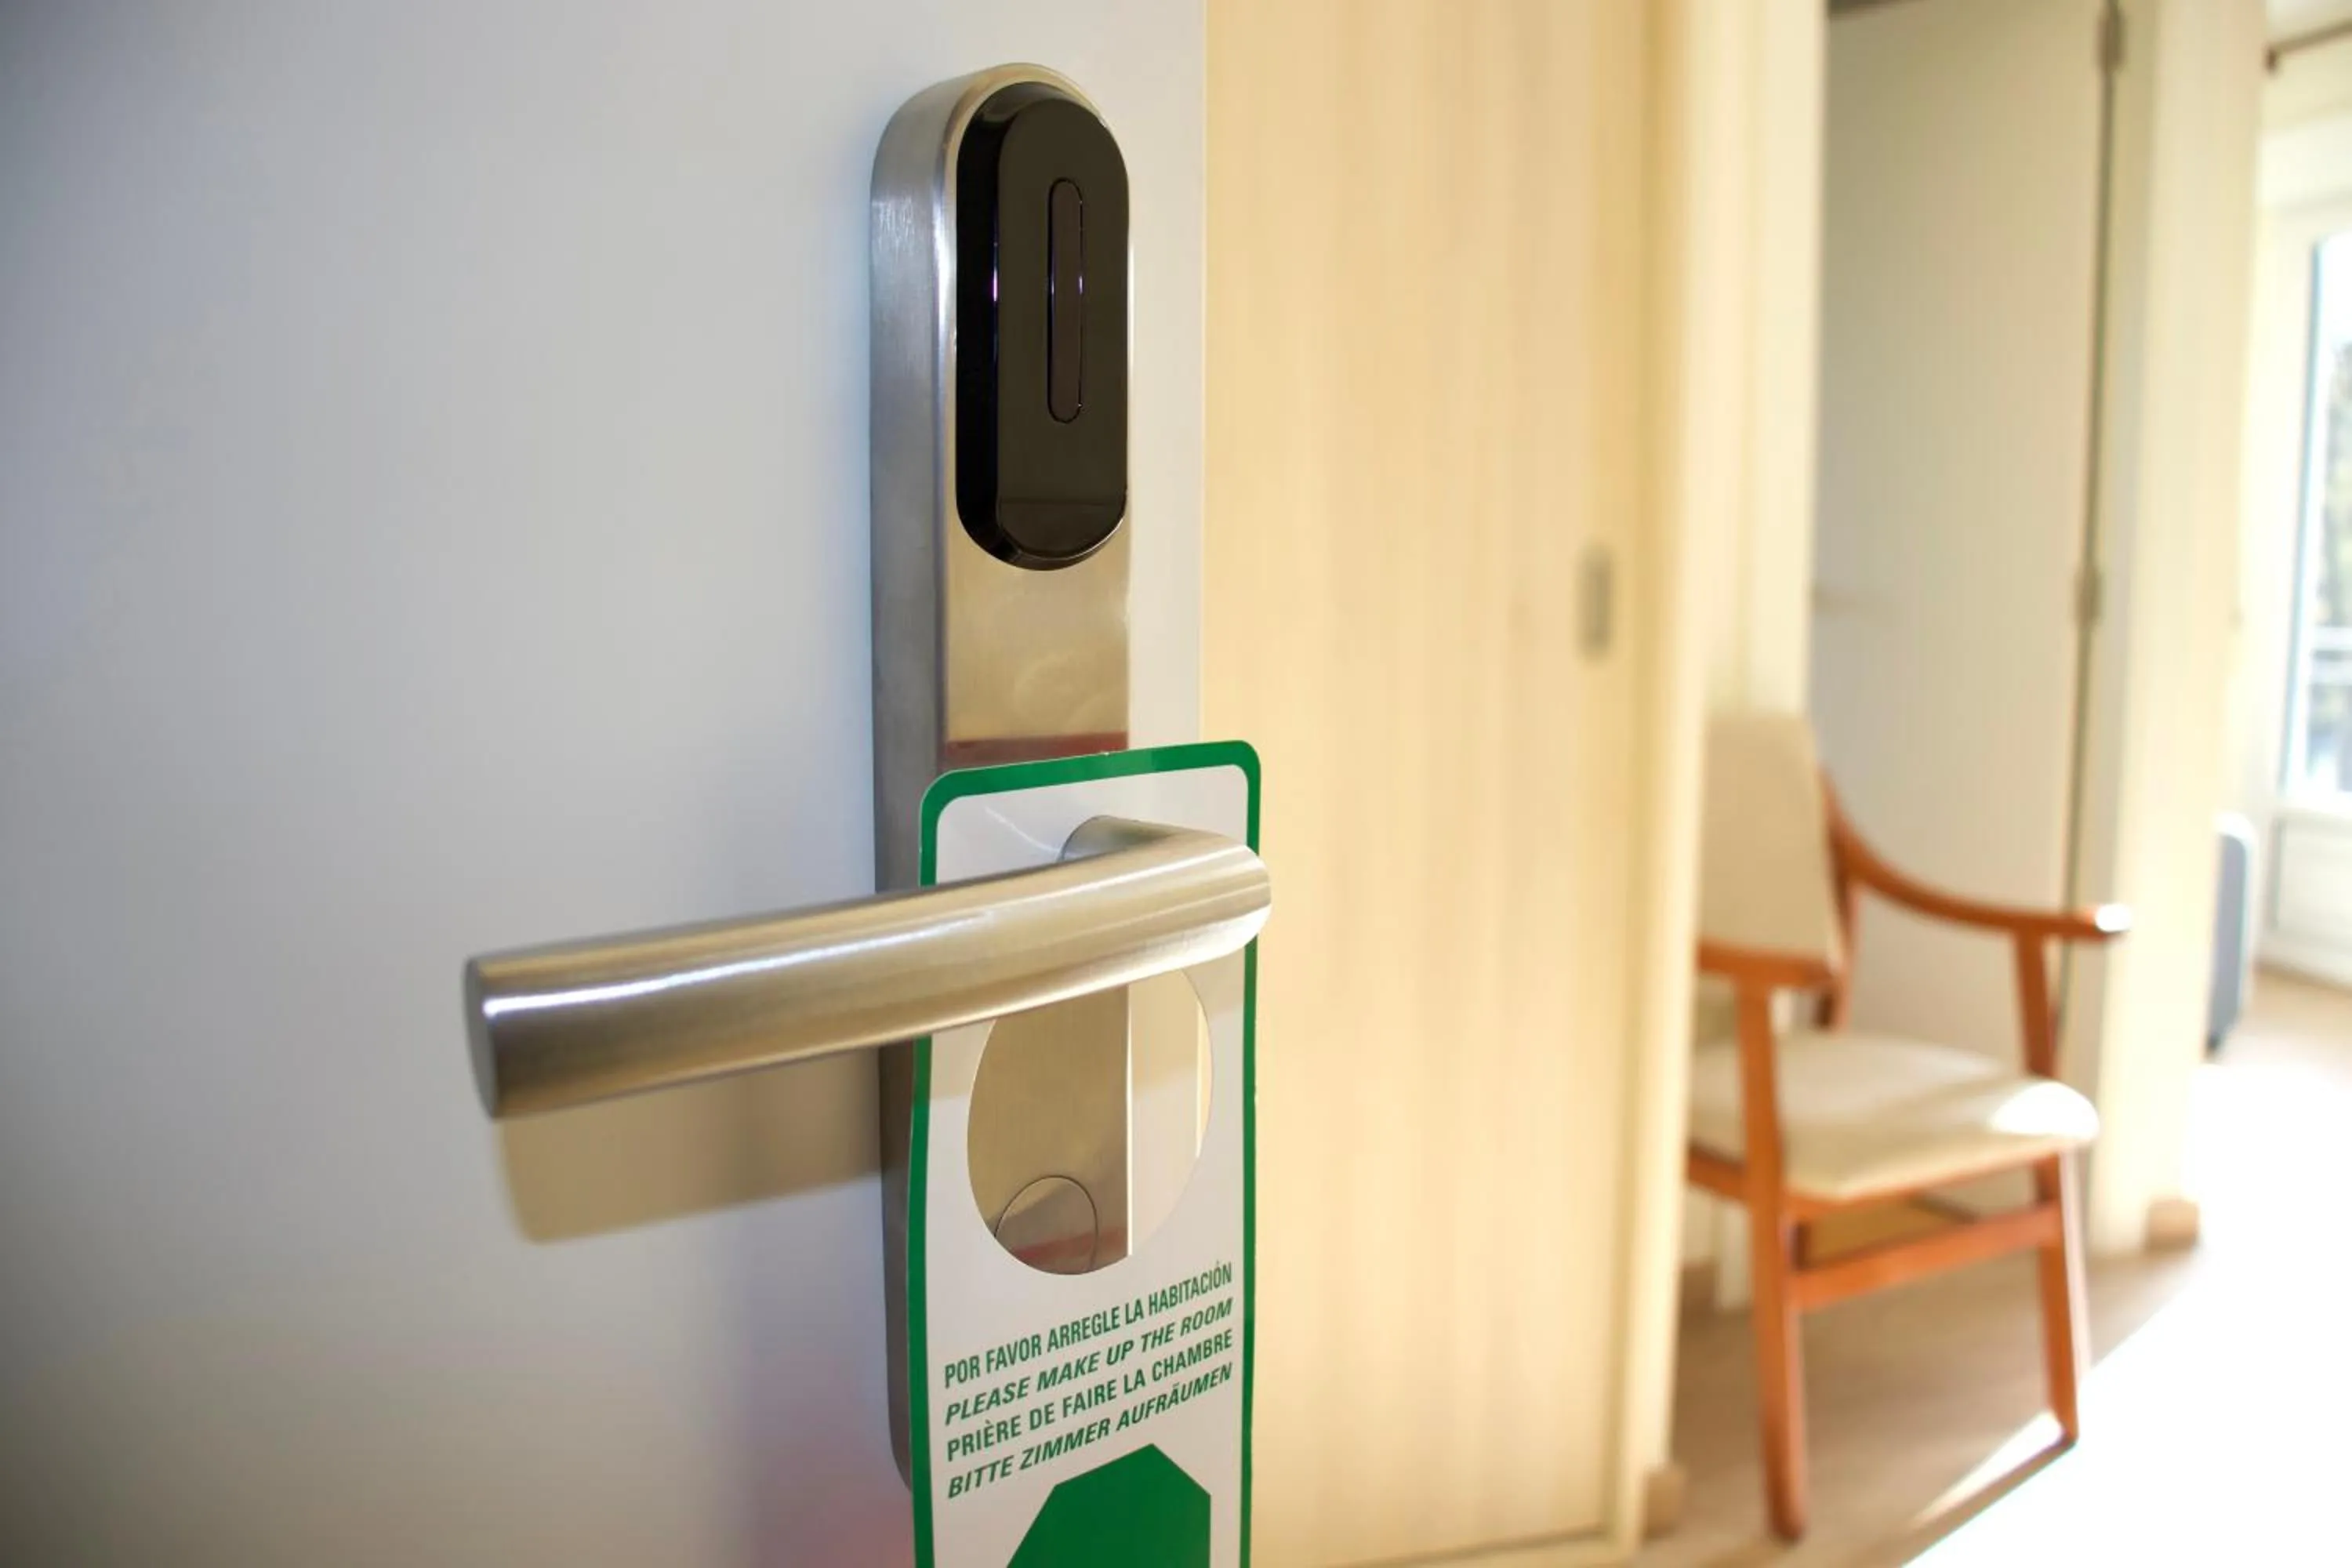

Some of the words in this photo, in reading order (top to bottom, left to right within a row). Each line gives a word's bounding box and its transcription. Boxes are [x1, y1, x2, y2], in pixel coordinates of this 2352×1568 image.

[945, 1355, 980, 1388] POR
[986, 1334, 1042, 1374] FAVOR
[1047, 1305, 1120, 1352] ARREGLE
[1125, 1298, 1145, 1325] LA
[1149, 1261, 1232, 1316] HABITACIÓN
[946, 1376, 1030, 1426] PLEASE
[1037, 1352, 1100, 1392] MAKE
[1106, 1339, 1134, 1365] UP
[1142, 1323, 1174, 1352] THE
[1181, 1298, 1233, 1336] ROOM
[948, 1415, 1021, 1461] PRIÈRE
[1029, 1403, 1054, 1430] DE
[1063, 1380, 1116, 1418] FAIRE
[1124, 1368, 1145, 1394] LA
[1152, 1329, 1232, 1381] CHAMBRE
[949, 1455, 1014, 1499] BITTE
[1020, 1418, 1111, 1471] ZIMMER
[1116, 1362, 1232, 1432] AUFRÄUMEN
